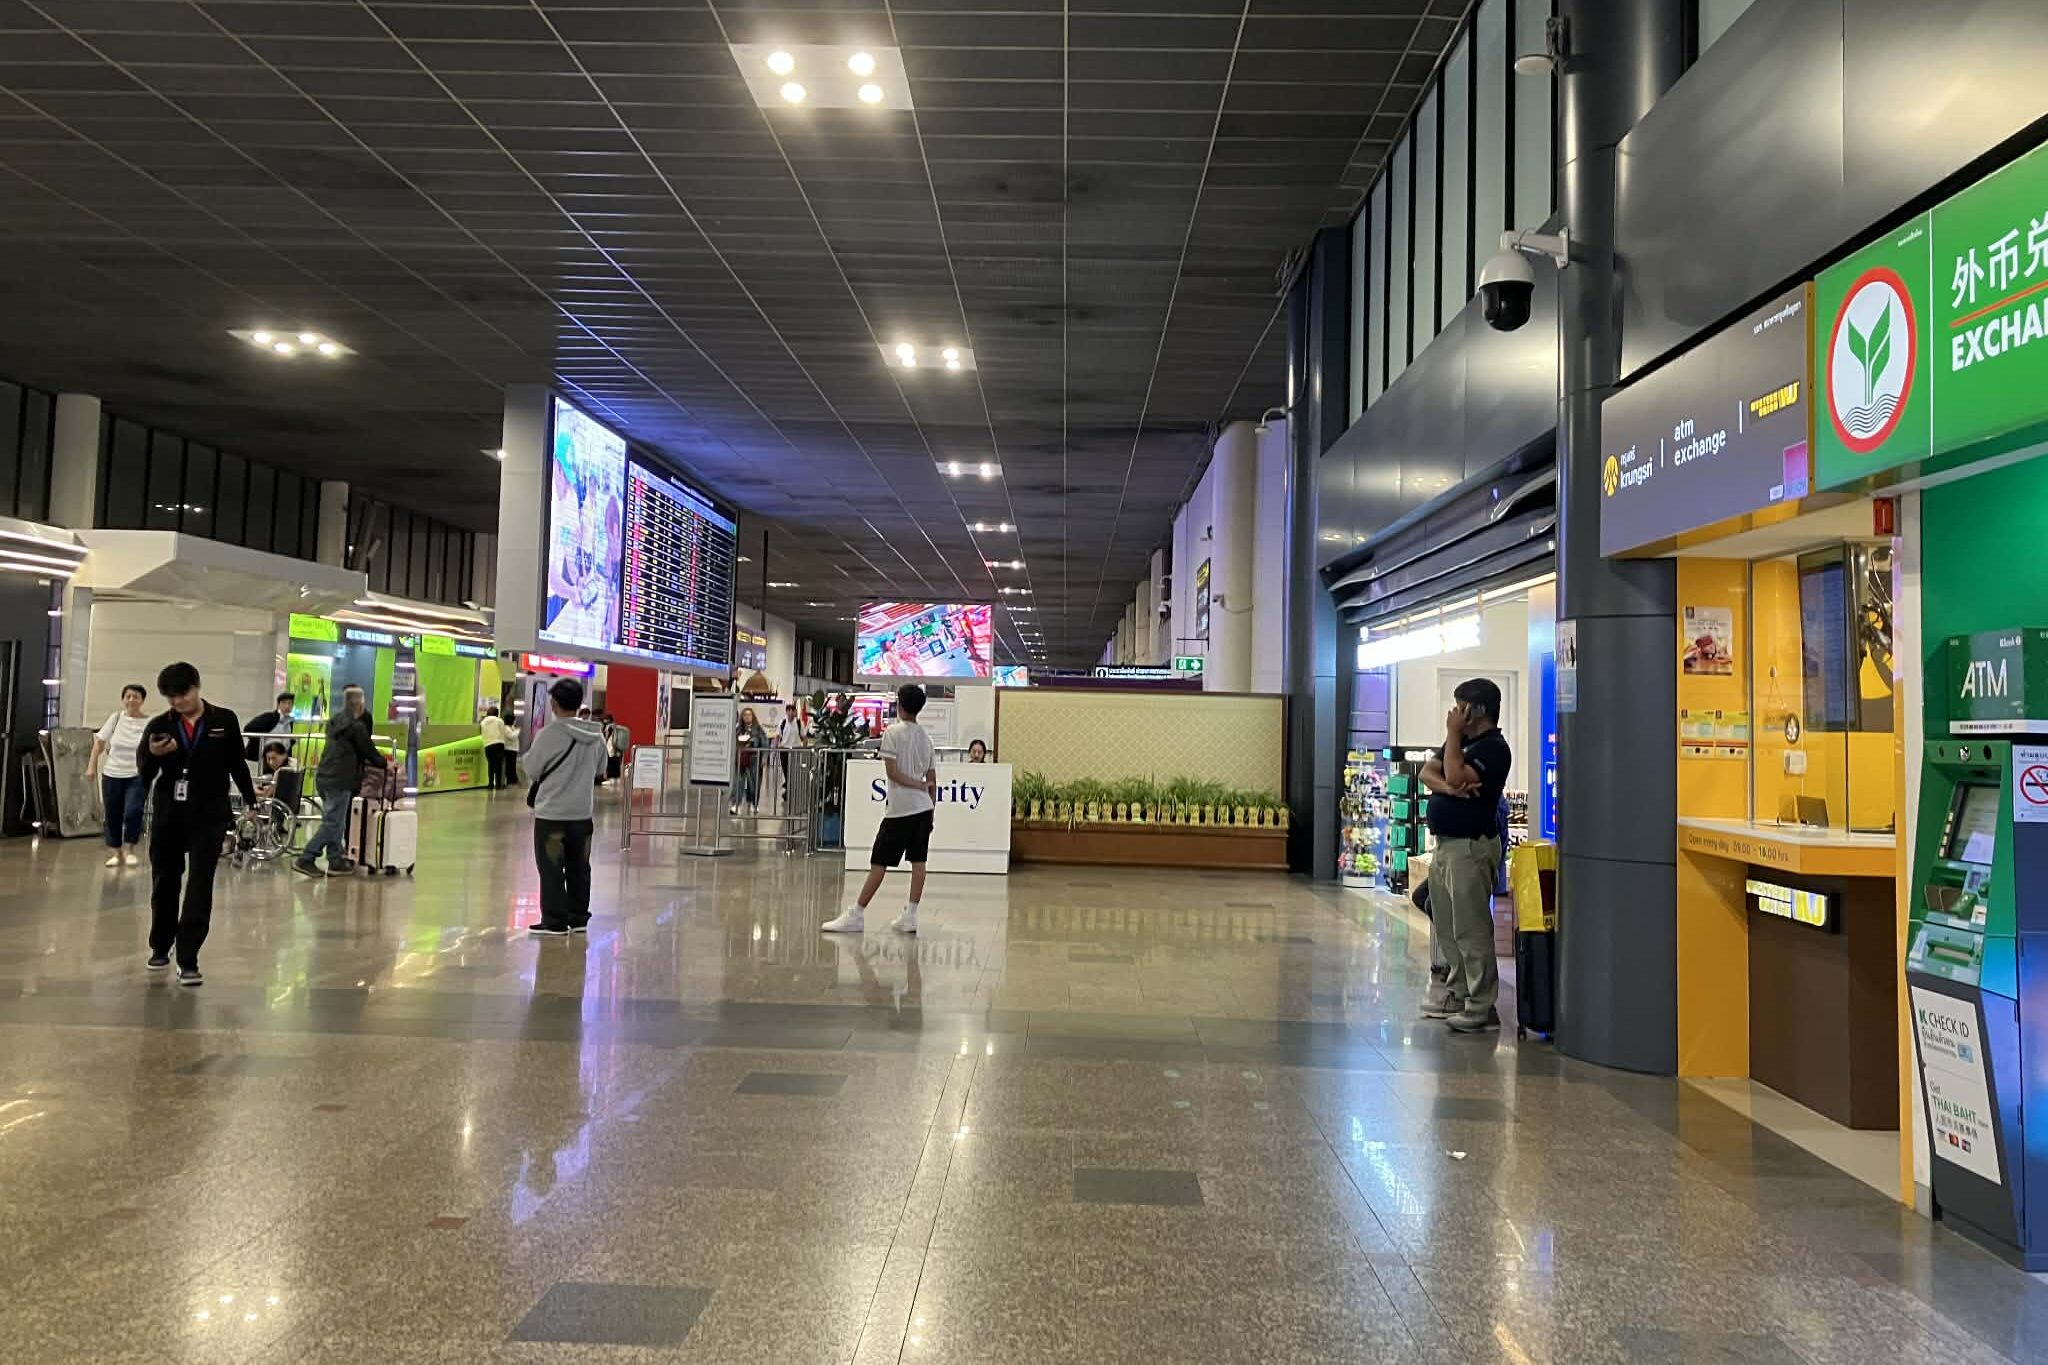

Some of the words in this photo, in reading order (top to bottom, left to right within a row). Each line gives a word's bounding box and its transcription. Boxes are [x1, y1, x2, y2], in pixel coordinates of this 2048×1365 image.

[1674, 419, 1694, 442] atm
[1674, 429, 1727, 466] exchange
[1620, 456, 1653, 489] krungsri
[1961, 658, 2008, 699] ATM
[871, 778, 985, 810] Srity
[1918, 1009, 1928, 1026] K
[1928, 1012, 1959, 1036] CHECK
[1960, 1020, 1970, 1038] ID
[1931, 1093, 1952, 1113] THAI
[1952, 1102, 1977, 1125] BAHT
